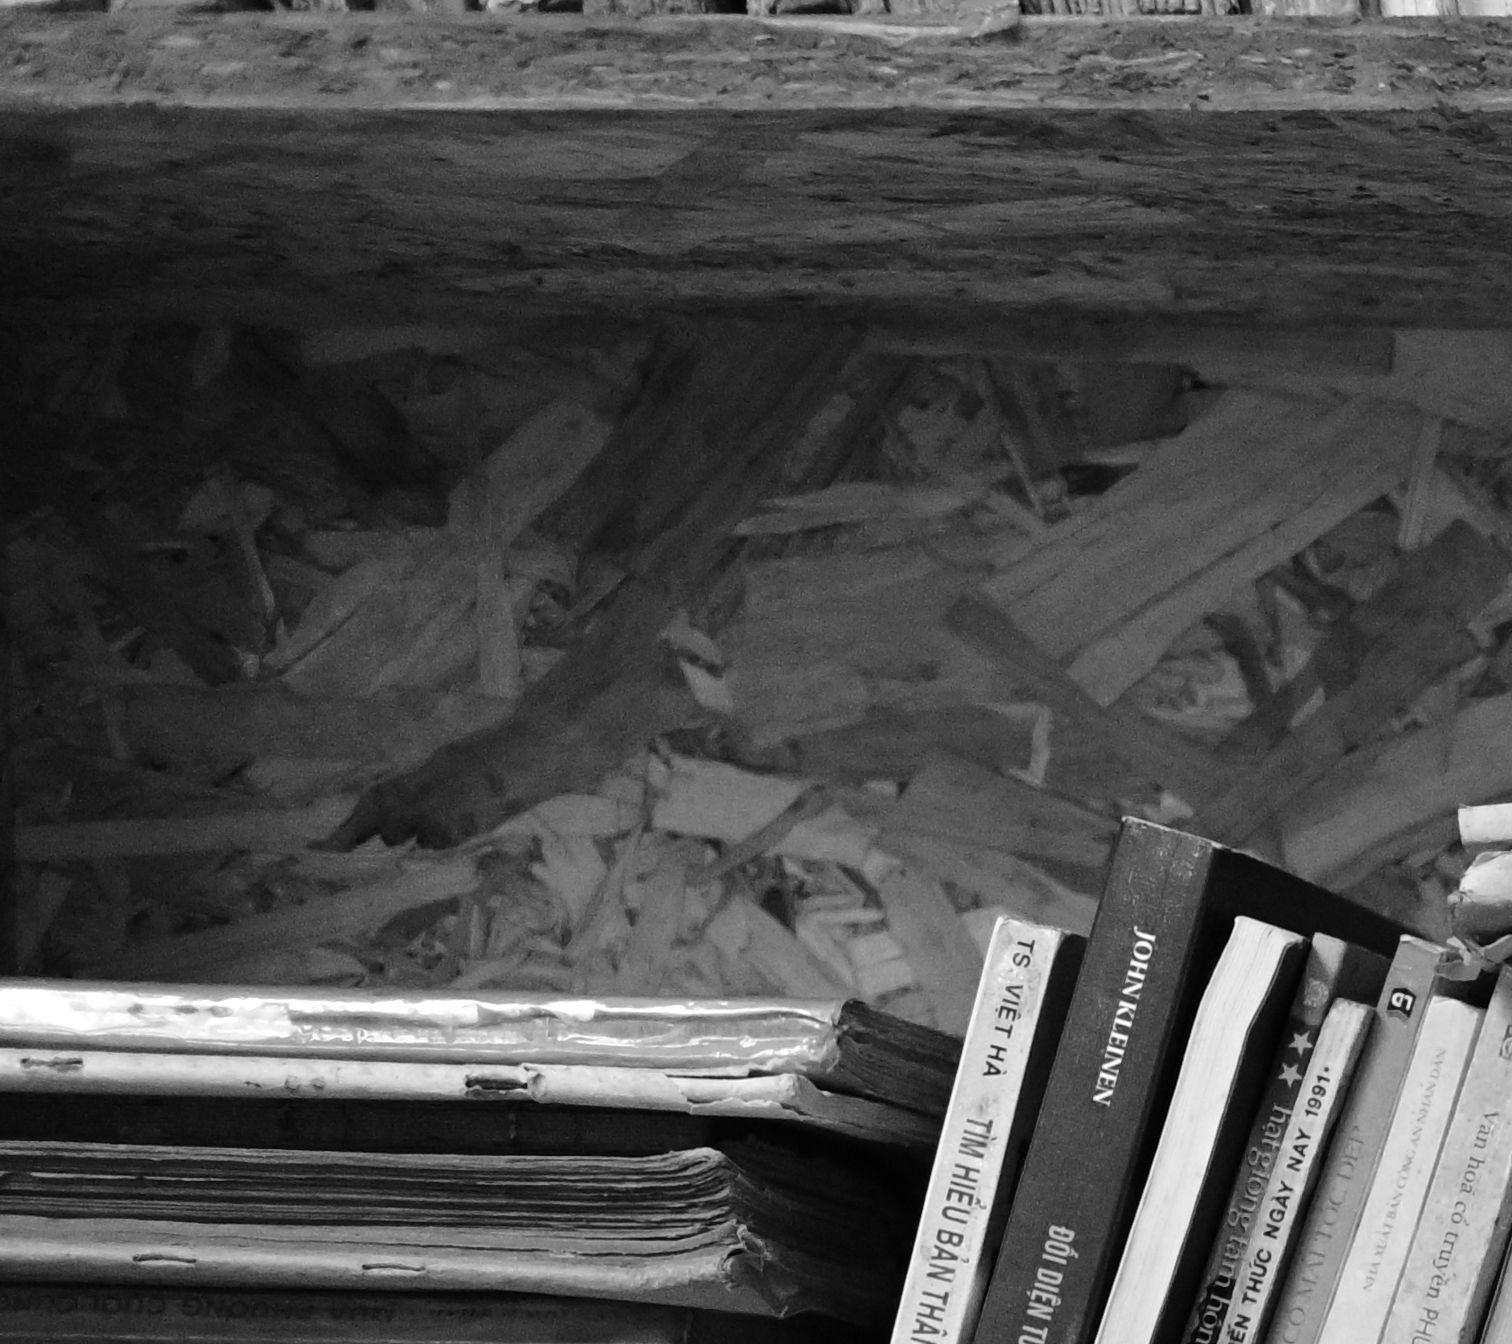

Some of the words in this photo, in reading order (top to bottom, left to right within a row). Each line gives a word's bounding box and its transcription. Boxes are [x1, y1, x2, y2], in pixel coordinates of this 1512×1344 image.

[1122, 925, 1156, 999] JOHN
[994, 985, 1023, 1039] VIỆT
[982, 1044, 1007, 1076] HÀ
[1093, 1000, 1137, 1106] KLEINEN
[958, 1119, 997, 1159] TÌM
[941, 1163, 983, 1224] HIỂU
[926, 1229, 969, 1283] BẢN
[1042, 1225, 1076, 1265] ĐỐI
[1026, 1267, 1063, 1320] DIỆN
